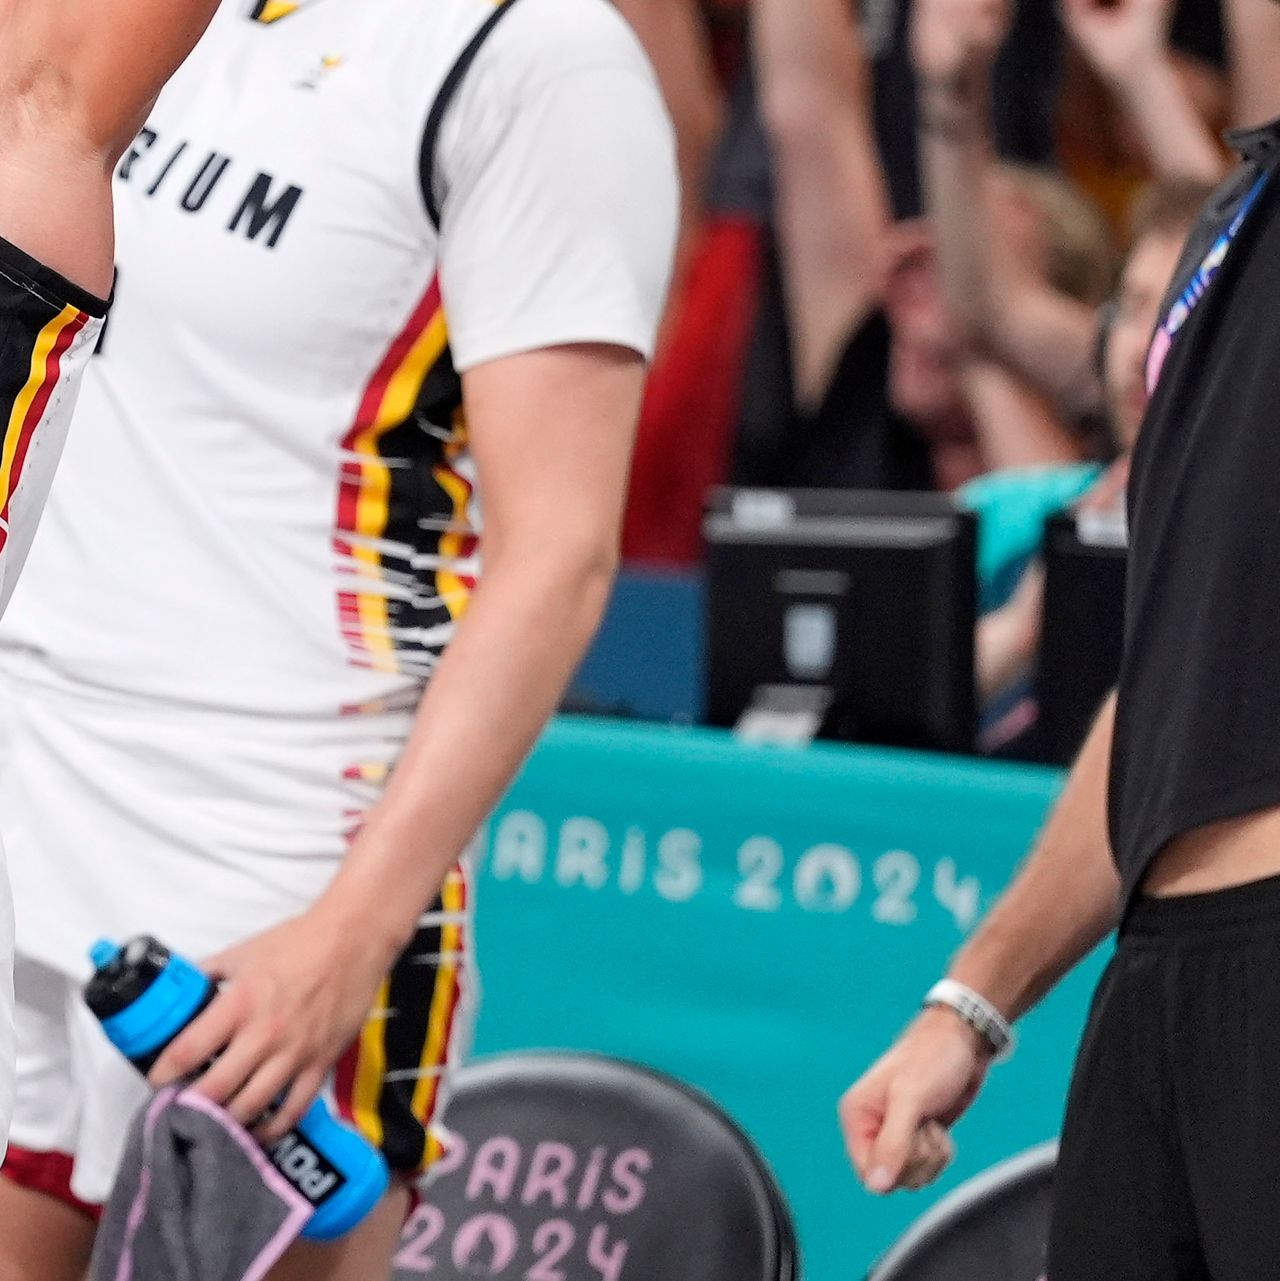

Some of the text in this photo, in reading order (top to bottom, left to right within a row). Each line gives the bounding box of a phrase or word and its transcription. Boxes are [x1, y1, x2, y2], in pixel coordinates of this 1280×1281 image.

[119, 127, 304, 249] GIUM
[474, 810, 981, 928] ARIS 2024
[396, 1203, 628, 1281] 2024
